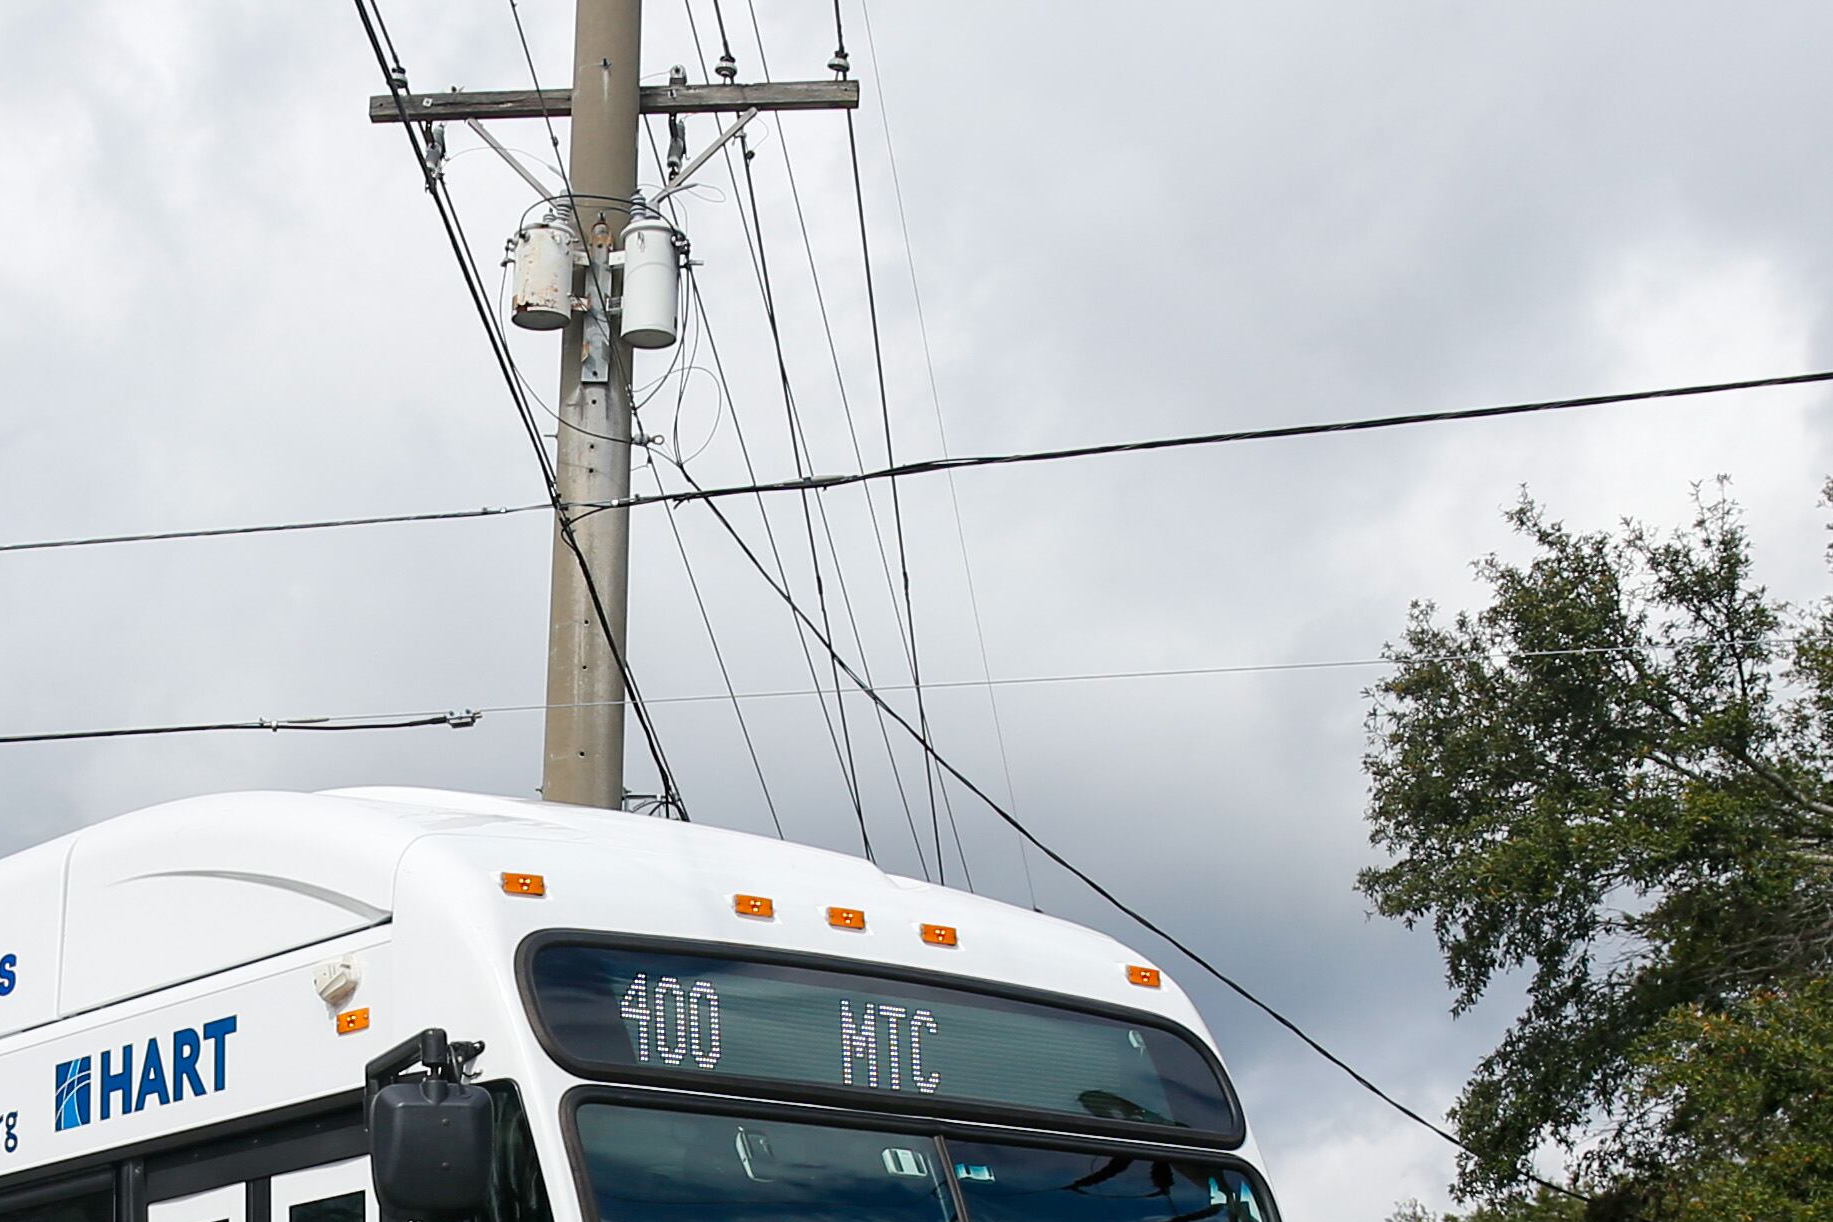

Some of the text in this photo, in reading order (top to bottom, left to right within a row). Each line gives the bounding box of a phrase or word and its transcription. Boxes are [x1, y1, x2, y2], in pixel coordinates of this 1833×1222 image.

[100, 1014, 237, 1121] HART
[620, 972, 721, 1069] 400
[840, 999, 941, 1093] MTC
